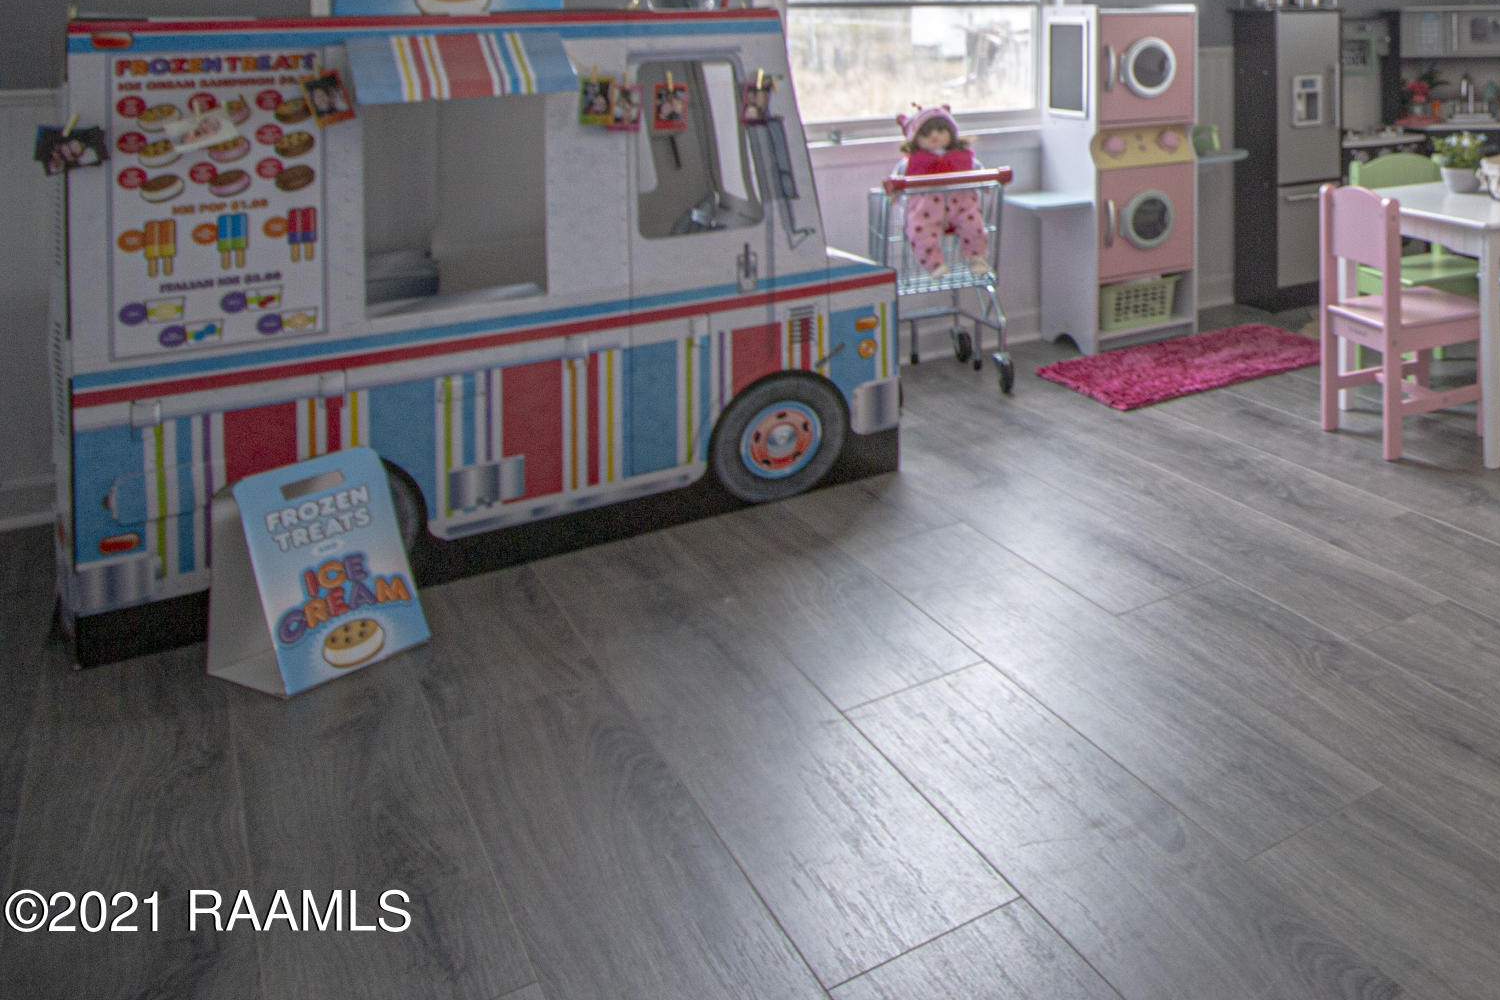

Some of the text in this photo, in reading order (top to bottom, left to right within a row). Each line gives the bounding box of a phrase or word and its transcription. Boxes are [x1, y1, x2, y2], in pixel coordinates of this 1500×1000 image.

[115, 57, 222, 76] FROZEN
[199, 202, 226, 213] POP
[265, 486, 370, 532] FROZEN
[272, 507, 371, 552] TREATS
[303, 553, 368, 597] ICE
[278, 576, 411, 644] CREAM
